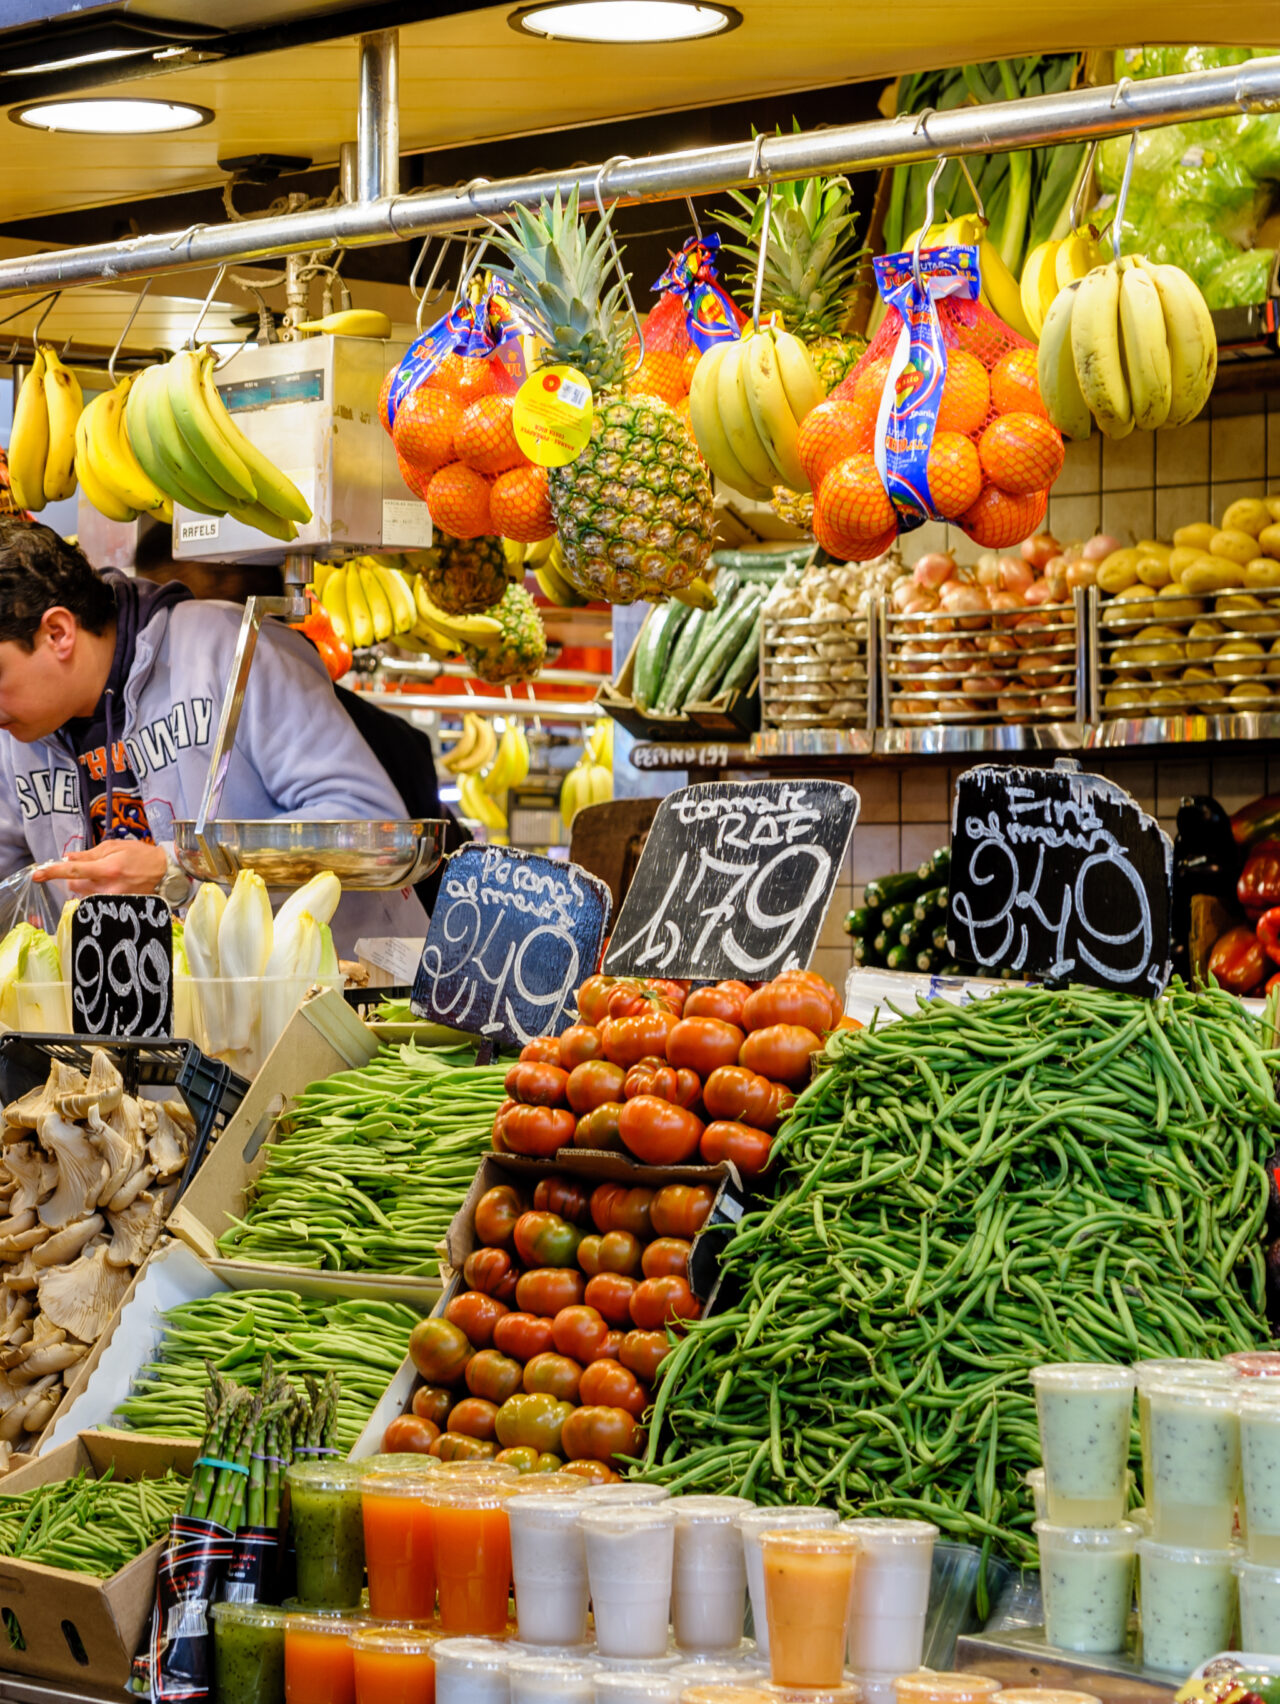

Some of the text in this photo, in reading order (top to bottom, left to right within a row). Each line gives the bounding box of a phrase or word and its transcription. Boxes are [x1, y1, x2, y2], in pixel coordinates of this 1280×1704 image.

[182, 523, 217, 539] RAFELS
[716, 810, 822, 850] RAF
[606, 845, 832, 974] 1,79
